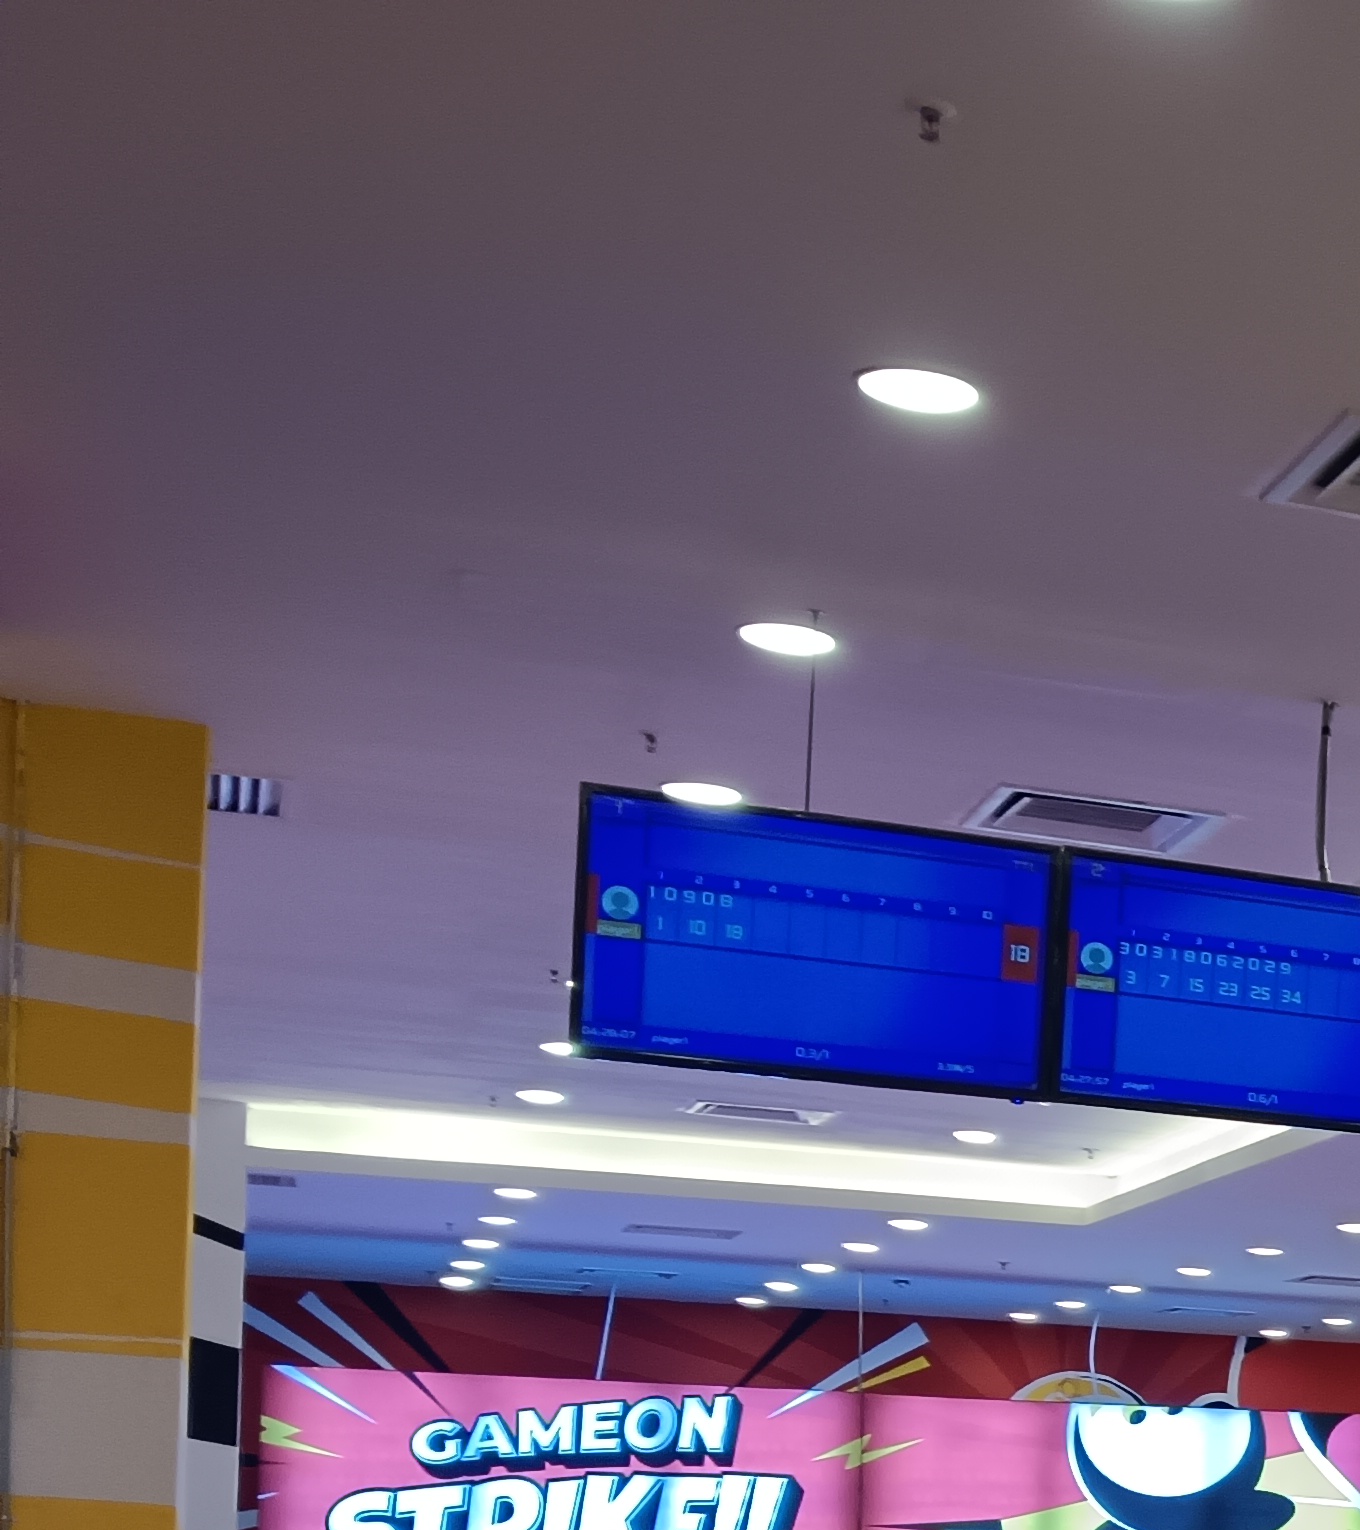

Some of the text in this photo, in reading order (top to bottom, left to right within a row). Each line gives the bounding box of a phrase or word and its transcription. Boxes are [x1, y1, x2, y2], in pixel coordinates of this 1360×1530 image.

[694, 875, 704, 885] 2
[768, 885, 778, 894] 4
[805, 888, 815, 898] 5
[841, 893, 851, 903] 6
[878, 897, 887, 906] 7
[656, 916, 744, 940] 1 10 18
[1009, 943, 1031, 963] 18
[1125, 970, 1137, 985] 3
[1159, 974, 1170, 988] 7
[1189, 978, 1205, 993] 15
[1218, 981, 1238, 997] 23
[1250, 986, 1271, 1001] 25
[1281, 989, 1301, 1004] 34
[410, 1395, 737, 1467] GAMEON
